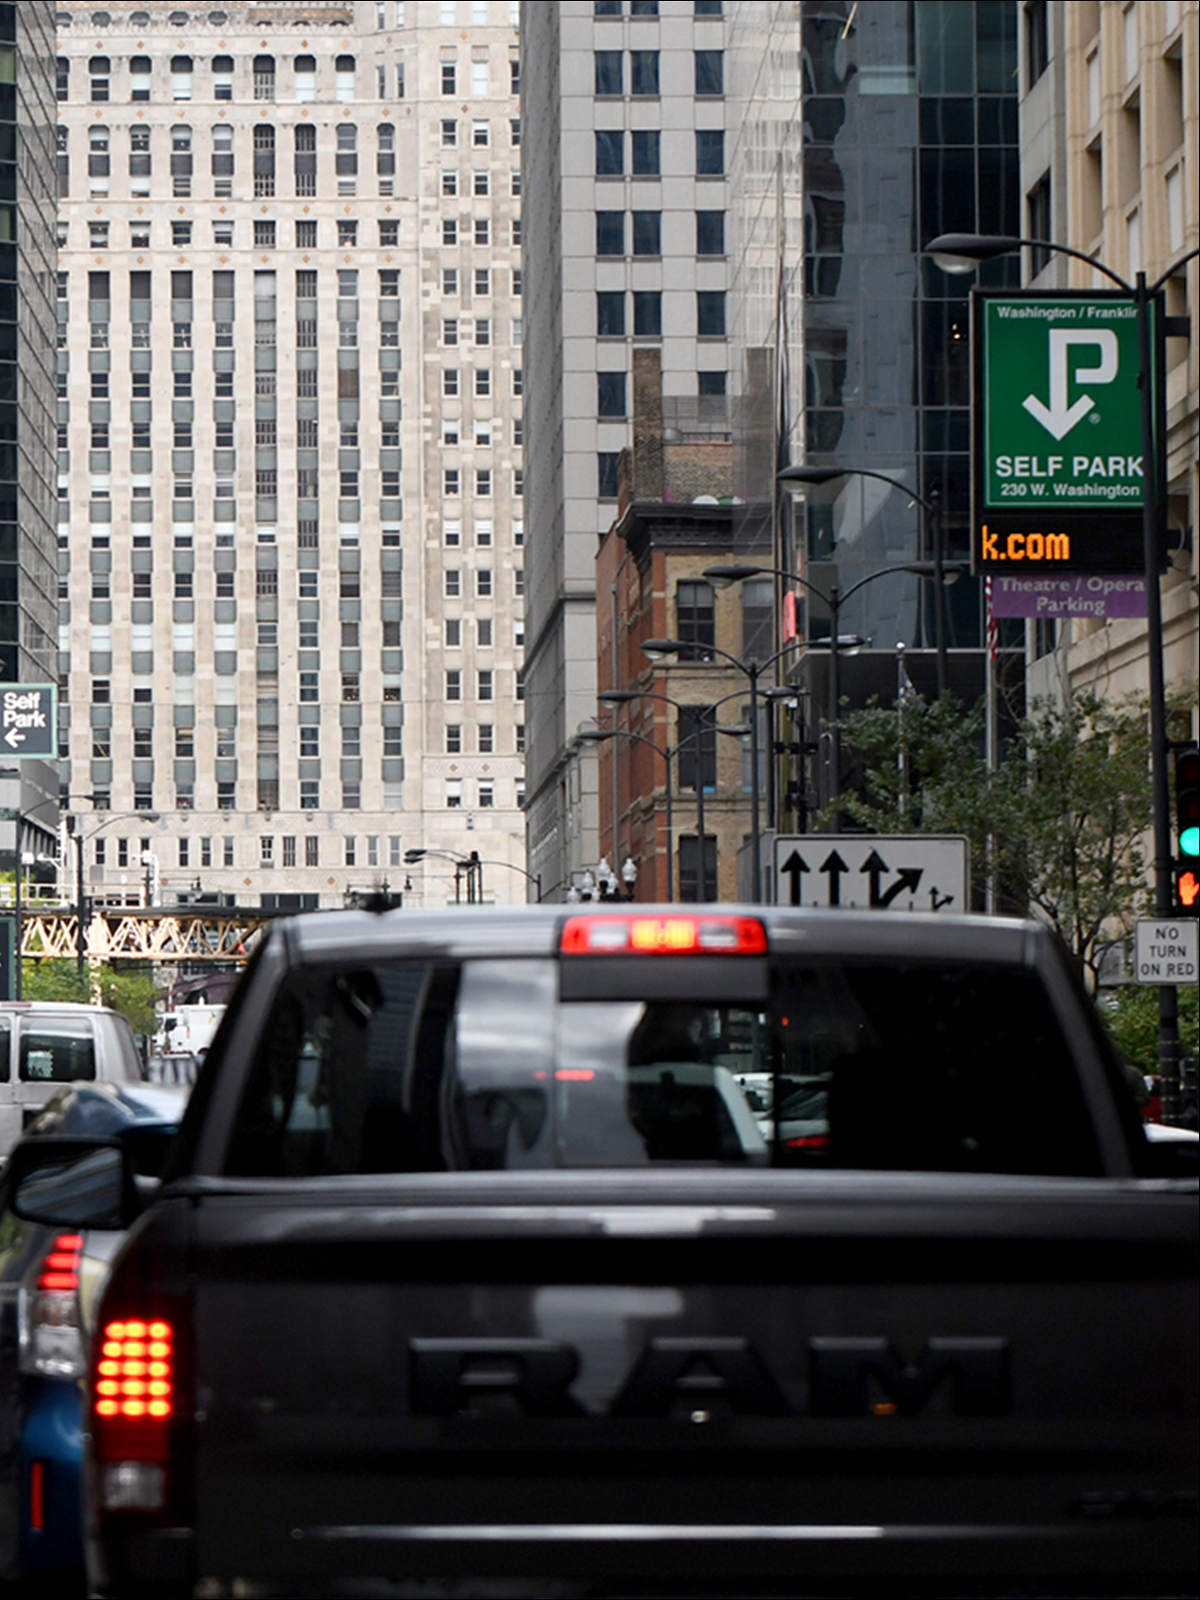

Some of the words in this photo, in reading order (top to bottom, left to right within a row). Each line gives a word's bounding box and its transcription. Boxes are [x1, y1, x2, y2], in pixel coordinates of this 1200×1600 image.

[997, 306, 1076, 321] Washington
[995, 456, 1064, 477] SELF
[1072, 456, 1144, 477] PARK
[1001, 483, 1028, 496] 230
[1030, 483, 1050, 496] W.
[1053, 483, 1141, 499] Washington
[982, 525, 1070, 560] k.com
[1000, 577, 1071, 592] Theatre
[1086, 577, 1145, 596] Opera
[1036, 597, 1106, 615] Parking
[3, 691, 41, 710] Self
[3, 710, 46, 728] Park
[1155, 926, 1179, 940] NO
[1149, 945, 1187, 958] TURN
[1140, 963, 1160, 976] ON
[1166, 962, 1195, 978] RED
[410, 1337, 1013, 1418] RAM
